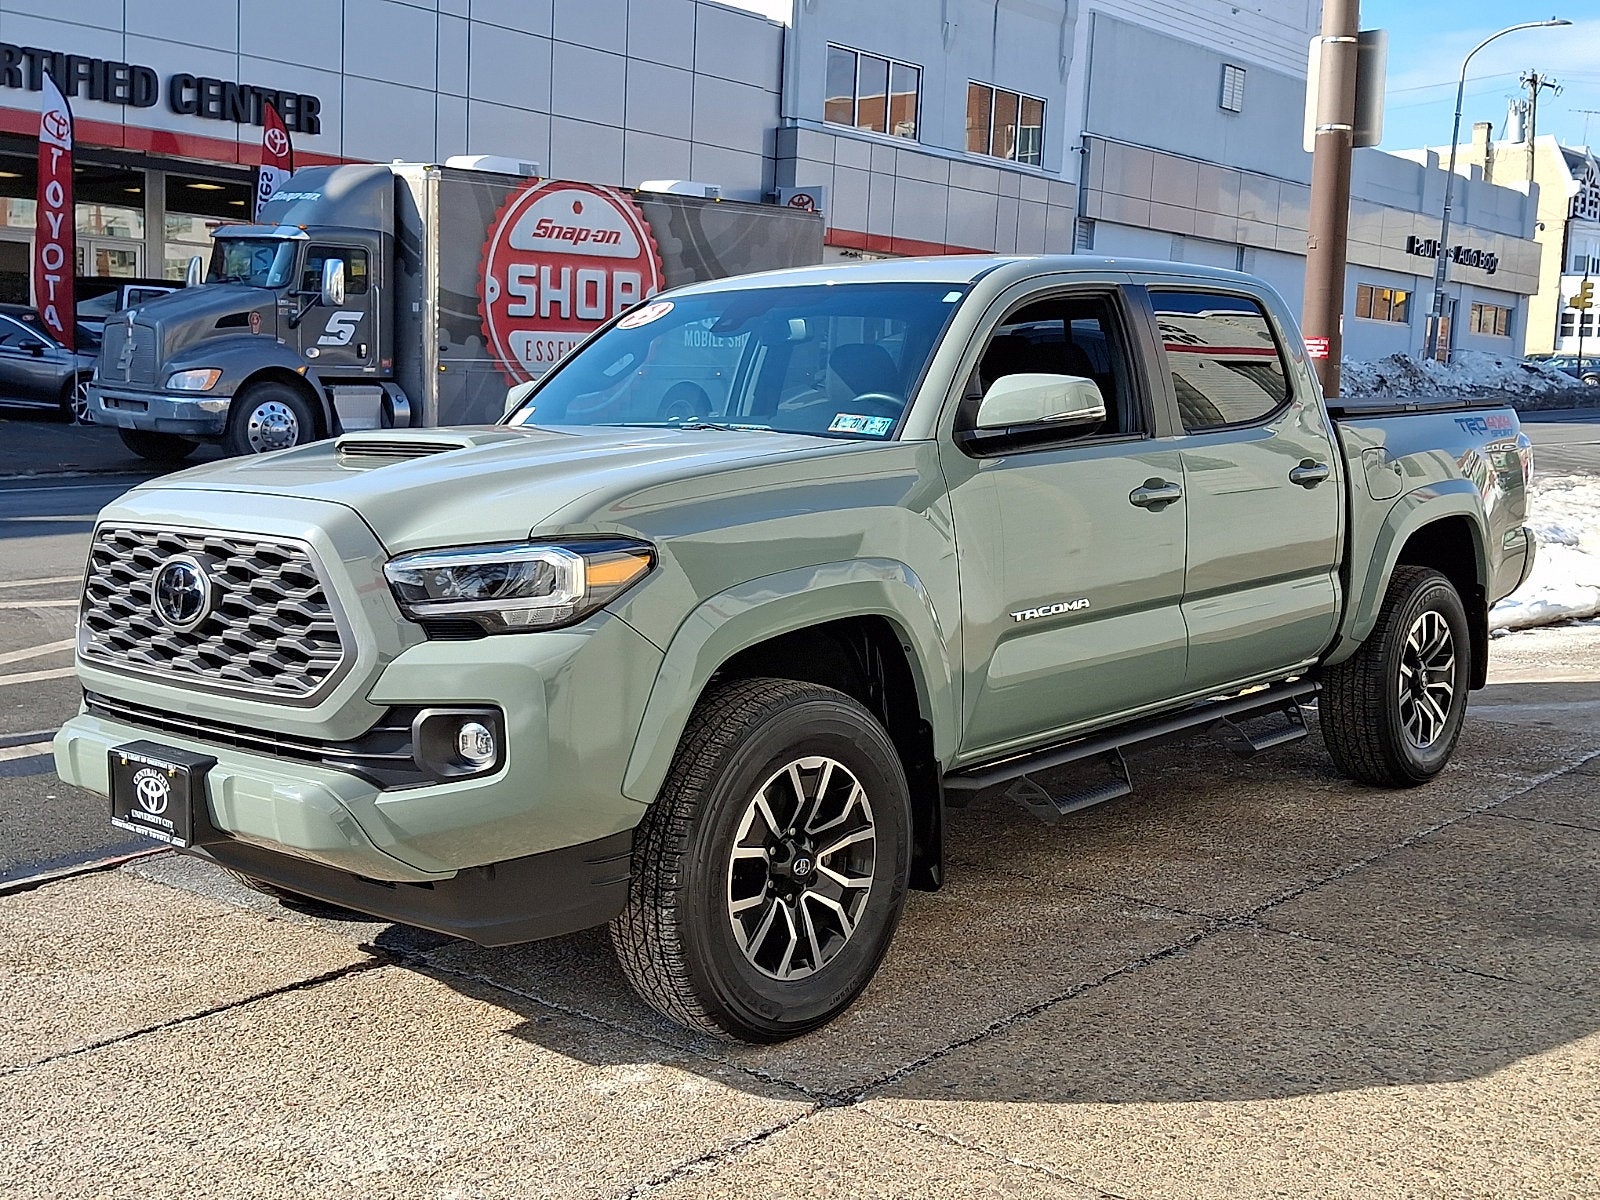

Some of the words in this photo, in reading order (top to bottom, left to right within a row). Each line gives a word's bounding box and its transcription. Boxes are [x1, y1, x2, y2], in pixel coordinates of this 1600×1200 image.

[170, 73, 322, 135] CENTER
[41, 147, 65, 333] TOYOTA
[532, 218, 622, 246] Snap-on
[1409, 236, 1436, 258] Paul
[1457, 246, 1479, 267] Auto
[1479, 252, 1499, 274] Body
[507, 263, 643, 320] SHOP
[684, 329, 724, 348] MOBILE
[1454, 416, 1488, 436] TRD
[1009, 598, 1091, 622] TACOMA
